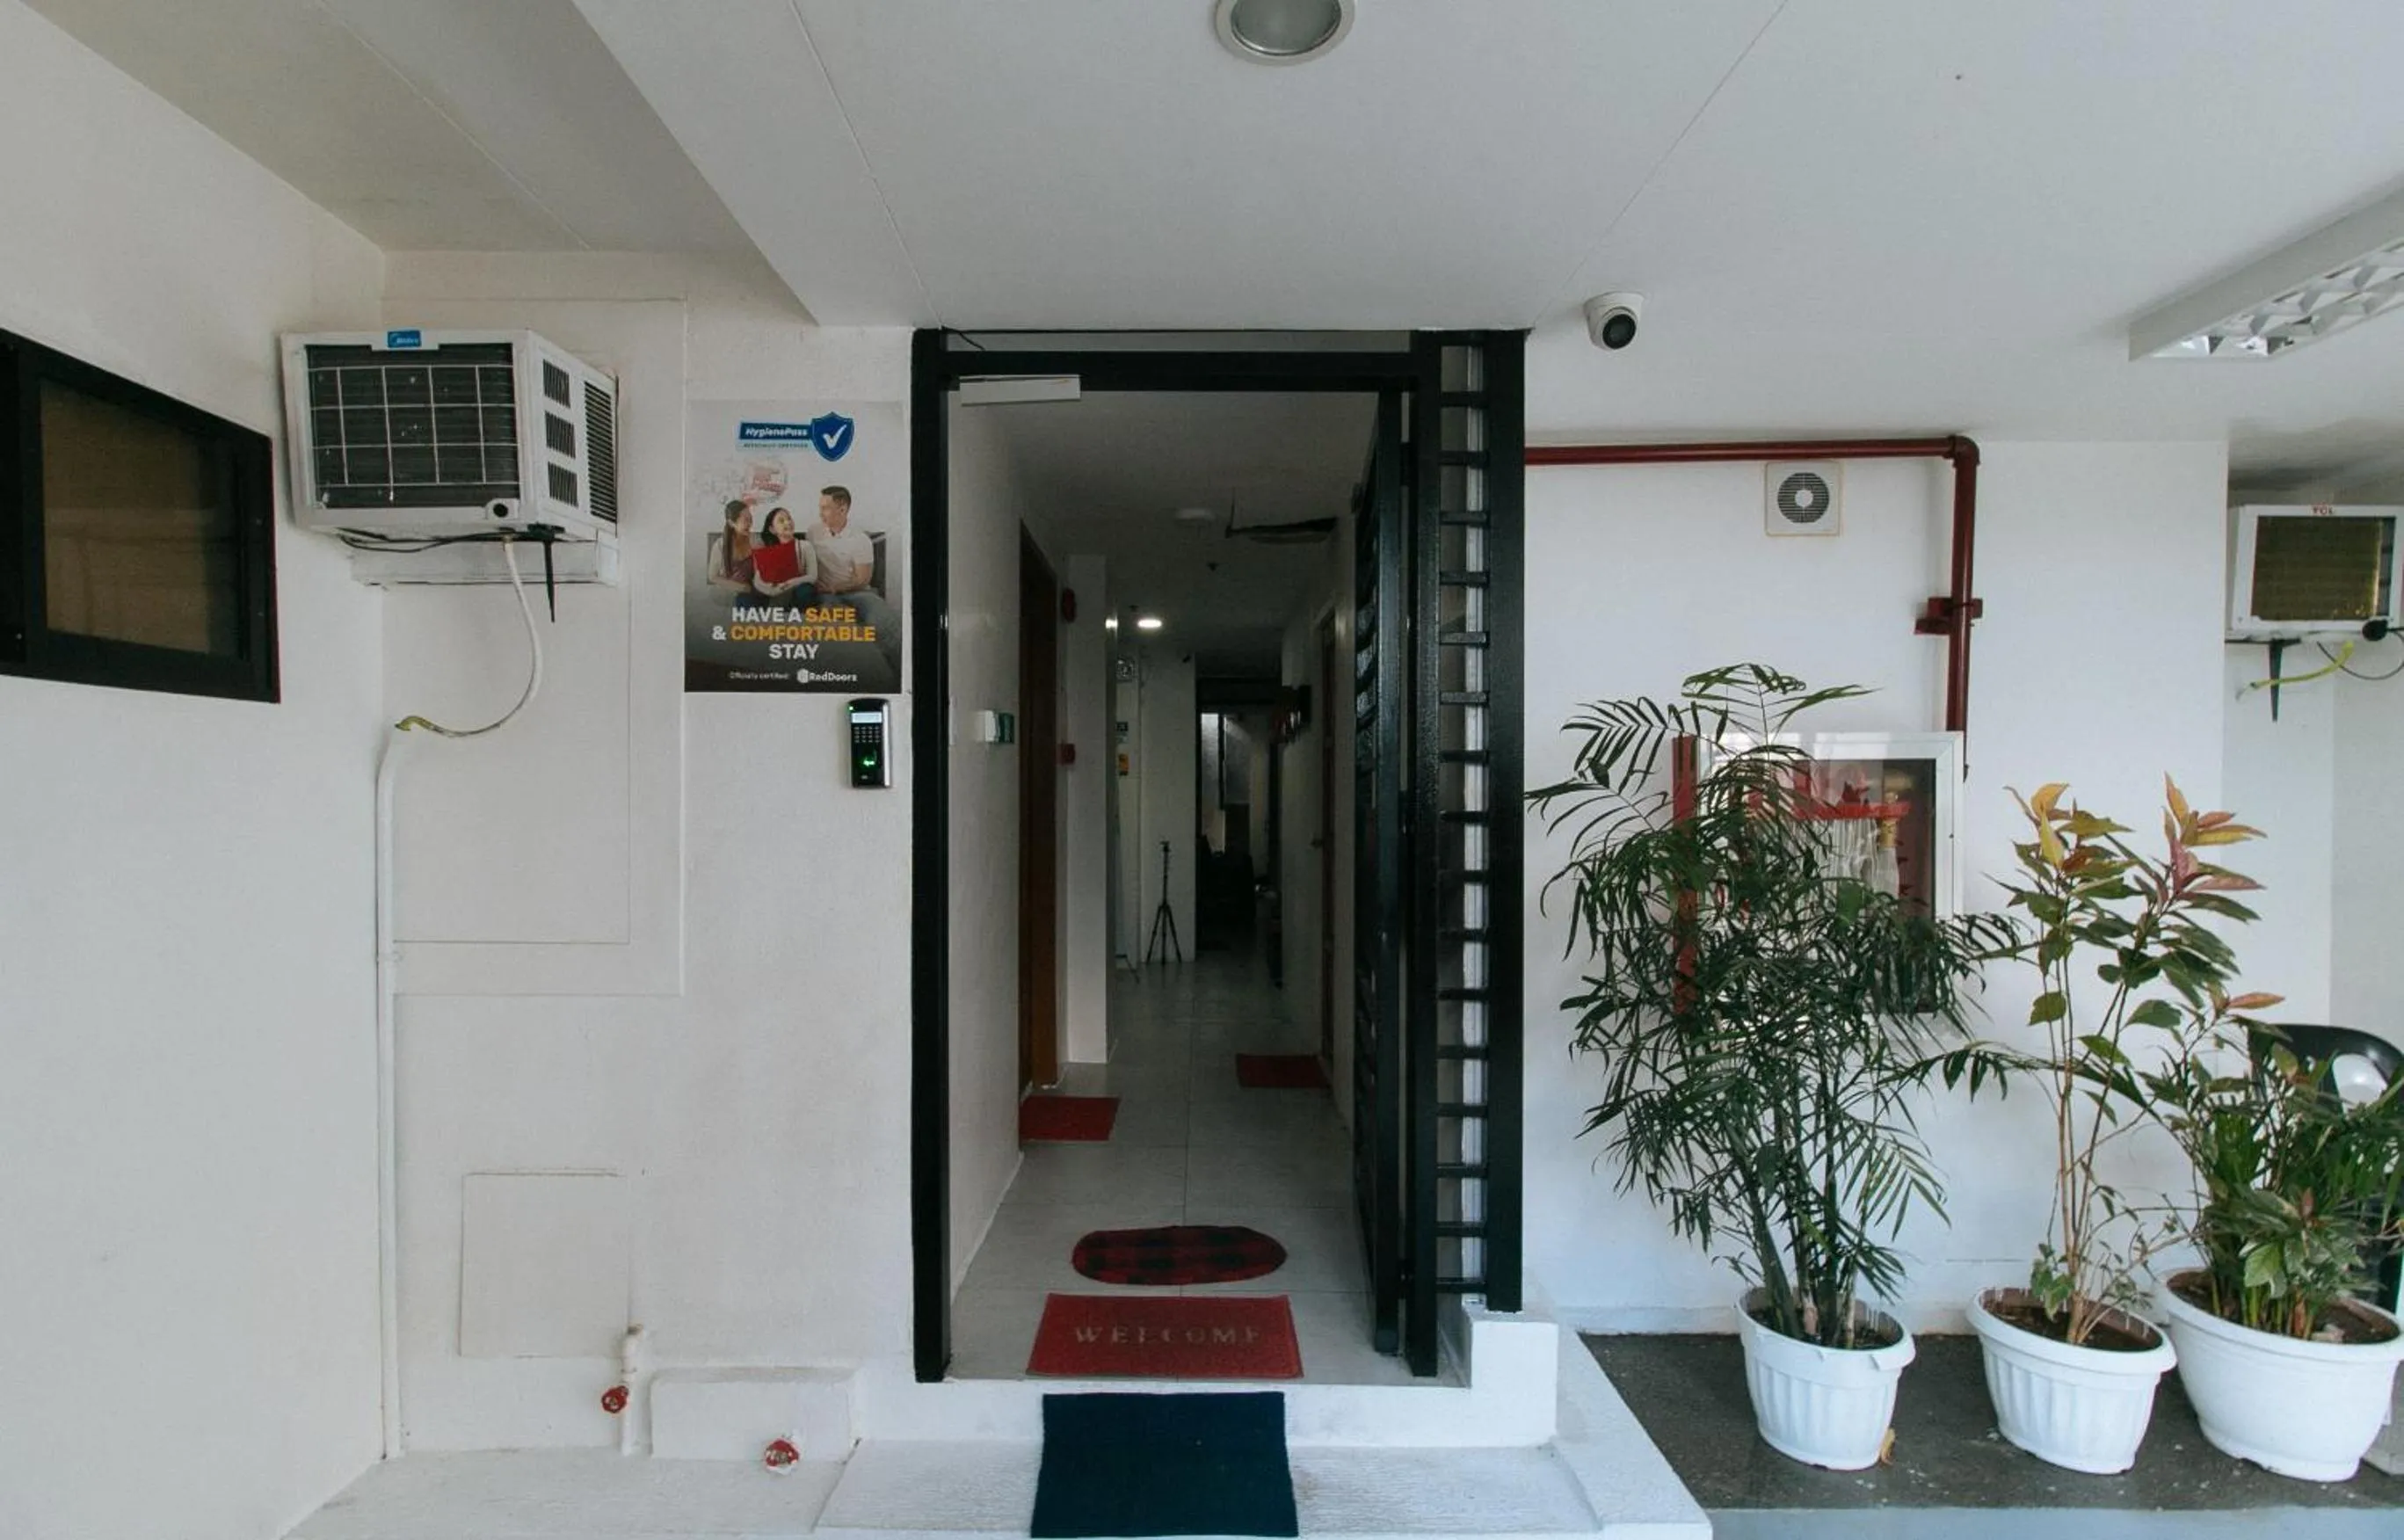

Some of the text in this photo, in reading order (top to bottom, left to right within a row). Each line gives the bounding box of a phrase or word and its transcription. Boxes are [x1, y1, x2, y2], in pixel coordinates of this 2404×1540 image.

[731, 607, 856, 623] HAVE A SAFE
[712, 625, 876, 642] & COMFORTABLE
[768, 643, 819, 659] STAY
[1075, 1326, 1260, 1344] WELCOME
